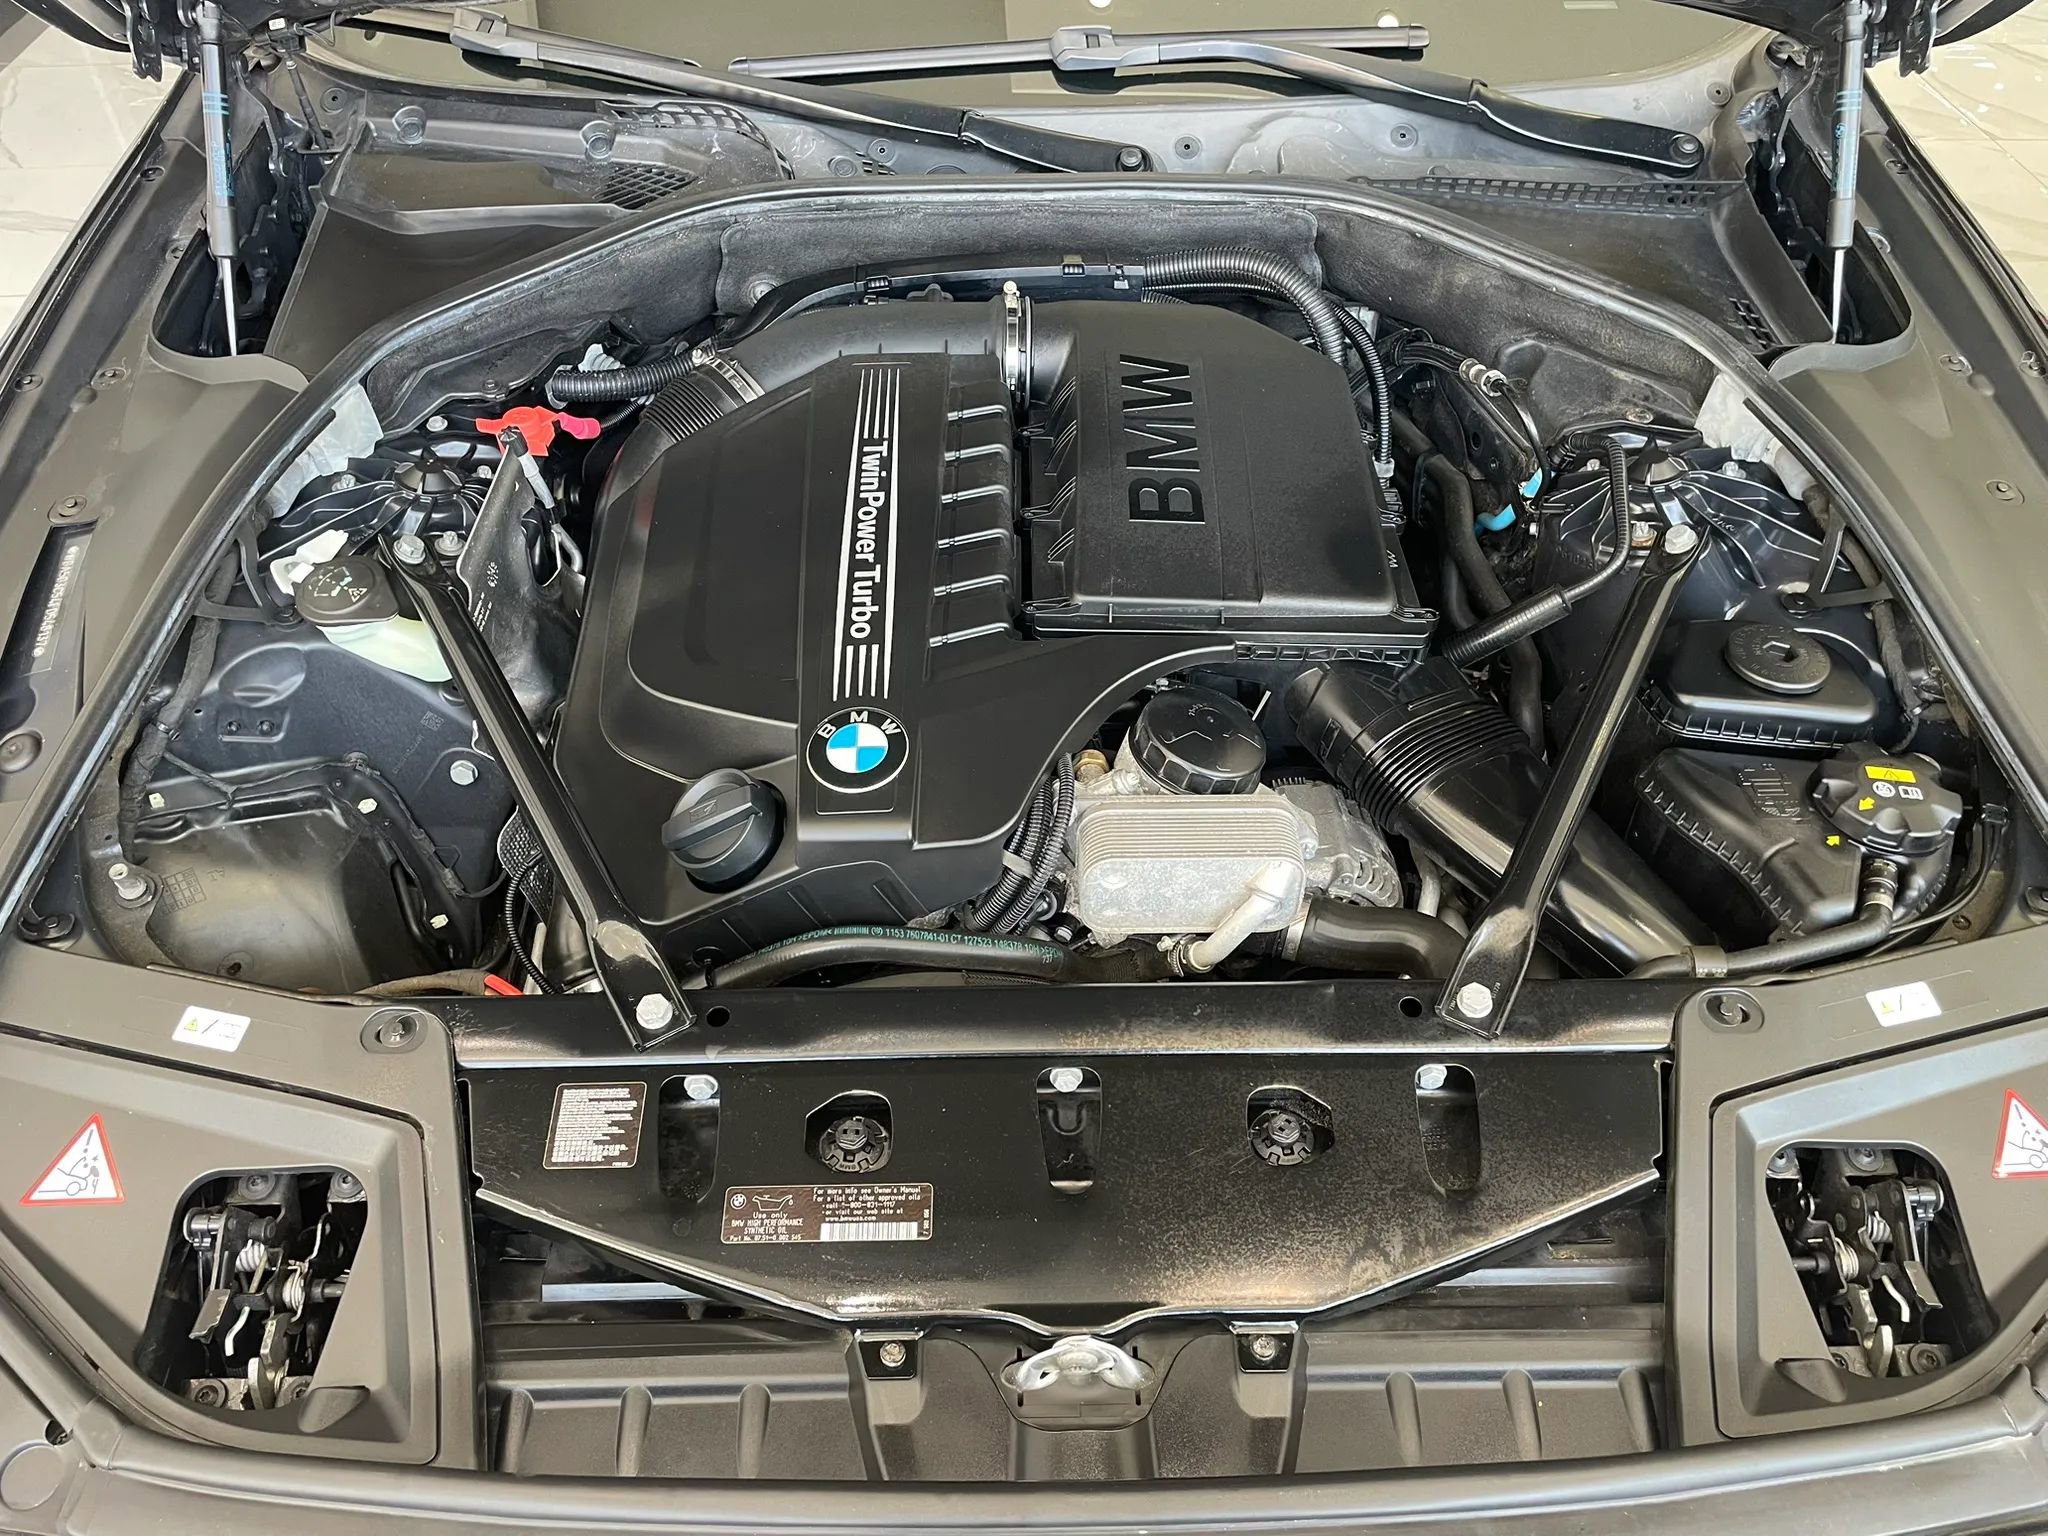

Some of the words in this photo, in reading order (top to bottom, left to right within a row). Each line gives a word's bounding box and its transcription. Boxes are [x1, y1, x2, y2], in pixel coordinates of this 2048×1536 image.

[1119, 353, 1206, 525] BMW
[854, 440, 889, 563] TwinPower
[849, 563, 882, 640] Turbo
[816, 710, 902, 739] BMW
[886, 928, 904, 938] 1153
[950, 933, 962, 944] CT
[964, 935, 993, 948] 127523
[813, 1187, 824, 1195] For
[844, 1187, 858, 1195] info
[874, 1186, 897, 1194] Owner's
[813, 1194, 824, 1202] For
[833, 1194, 846, 1202] list
[878, 1194, 906, 1202] approved
[752, 1211, 767, 1219] Use
[770, 1210, 788, 1220] only
[731, 1219, 745, 1228] BMW
[746, 1219, 761, 1227] HIGH
[763, 1218, 804, 1227] PERFORMANCE
[743, 1226, 776, 1235] SYNTHETIC
[777, 1226, 788, 1234] OIL
